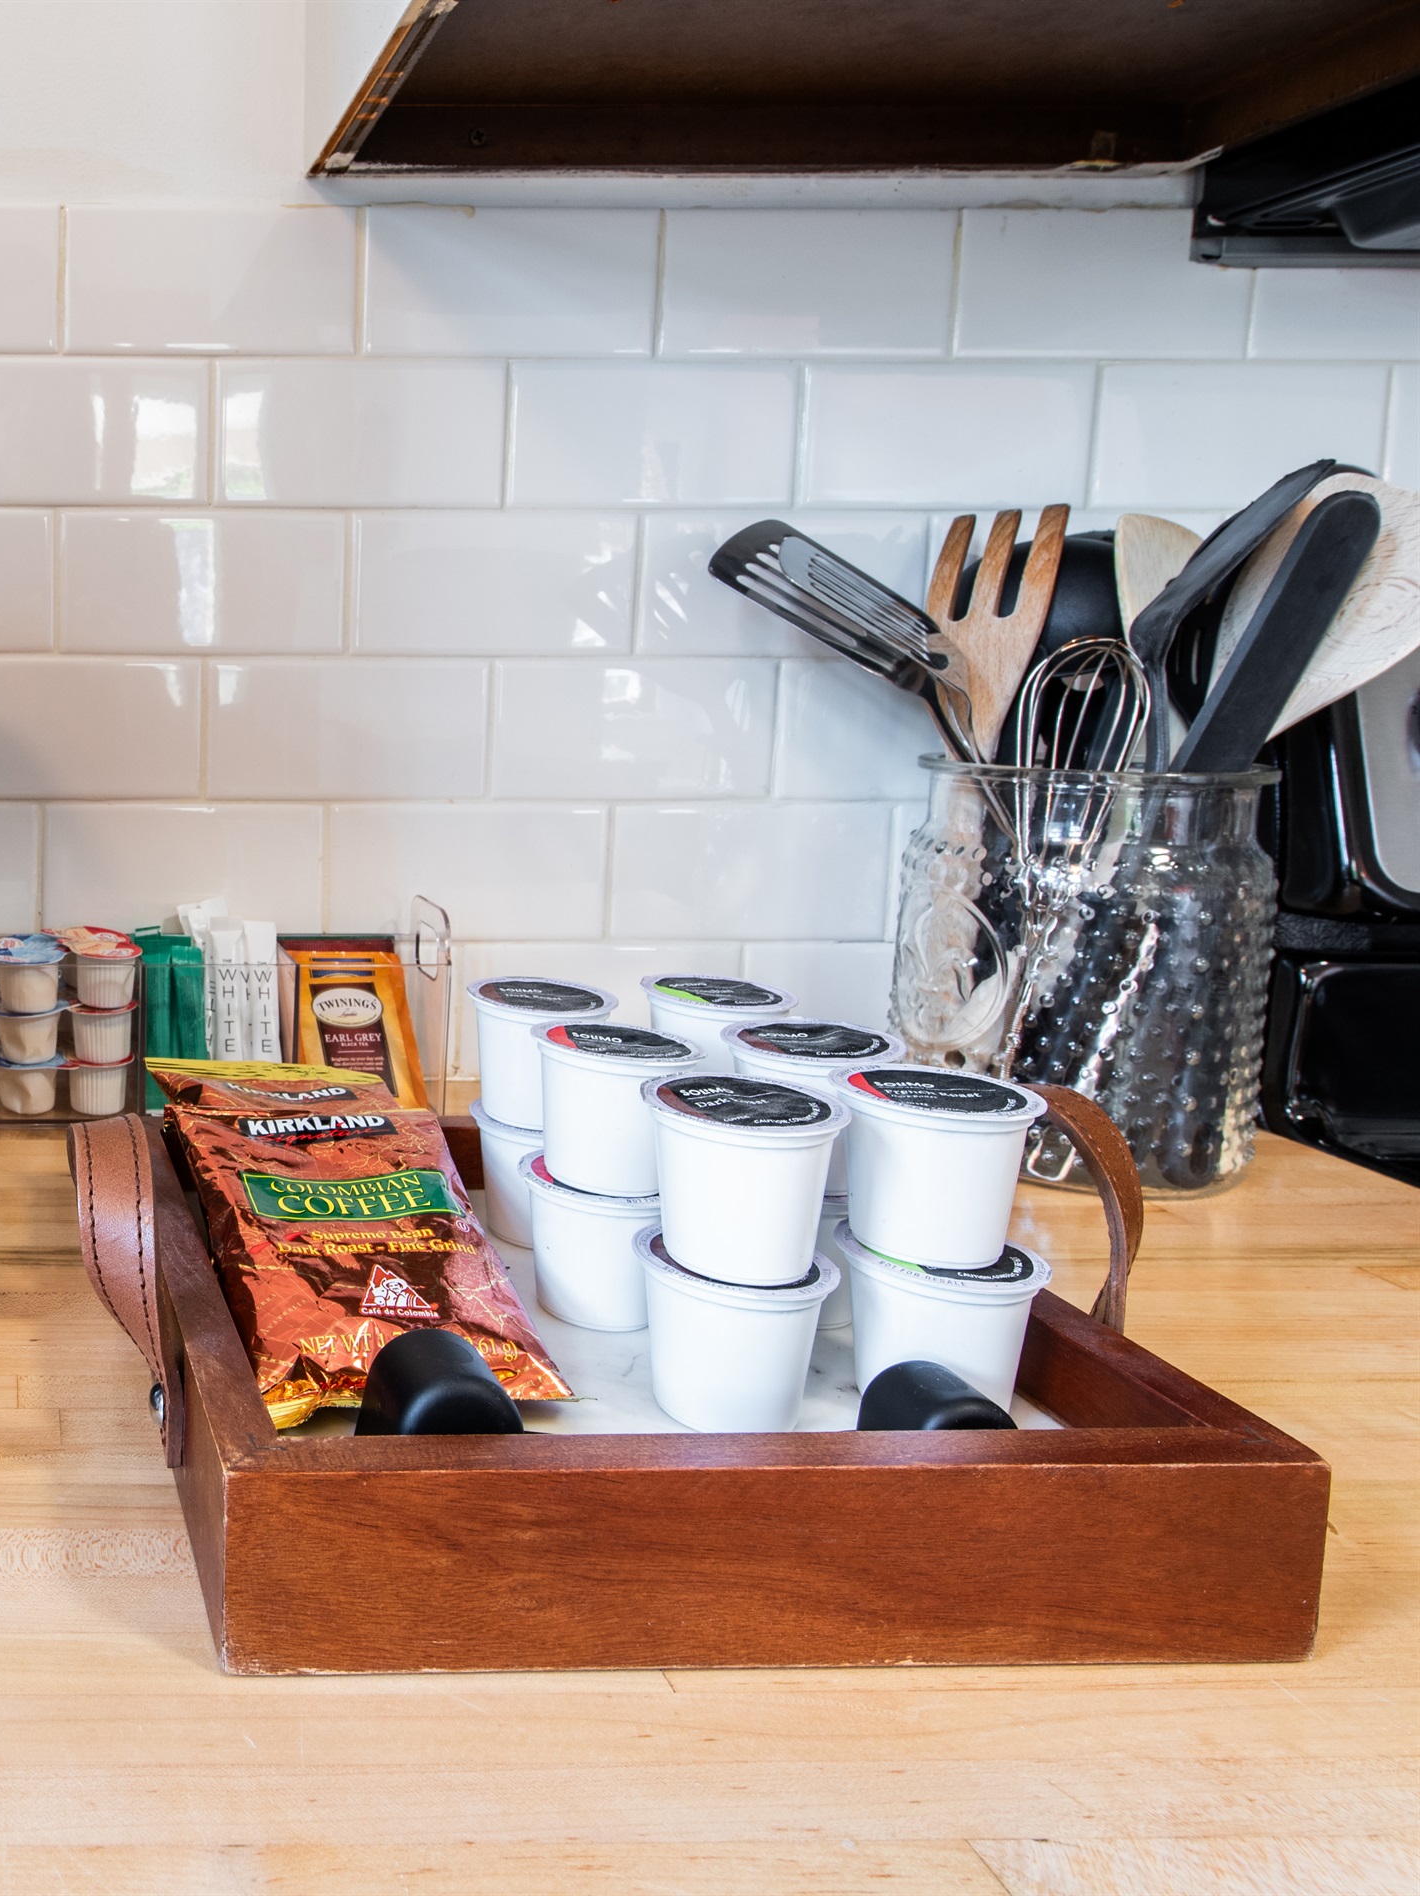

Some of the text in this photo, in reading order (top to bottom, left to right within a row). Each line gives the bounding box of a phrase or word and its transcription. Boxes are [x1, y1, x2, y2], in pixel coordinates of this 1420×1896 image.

[218, 968, 237, 1053] WHITE
[254, 969, 273, 1053] WHITE
[316, 998, 377, 1012] TWININGS
[324, 1032, 382, 1043] EARL GREY
[571, 1031, 623, 1044] SOLIMO
[227, 1082, 347, 1100] KIRKLAND
[679, 1087, 735, 1098] SOLIMO
[873, 1081, 935, 1089] SOLIMO
[695, 1097, 729, 1109] Dark
[247, 1115, 386, 1136] KIRKLAND
[270, 1174, 421, 1197] COLOMBIAN
[277, 1187, 431, 1216] COFFEE
[311, 1227, 434, 1242] Supremo Bean
[277, 1242, 324, 1257] Dark
[324, 1242, 373, 1256] Roast
[387, 1241, 426, 1253] Fine
[429, 1238, 477, 1256] Grind
[361, 1307, 439, 1318] Café de Colombia
[300, 1335, 337, 1355] NET
[341, 1333, 372, 1354] WT
